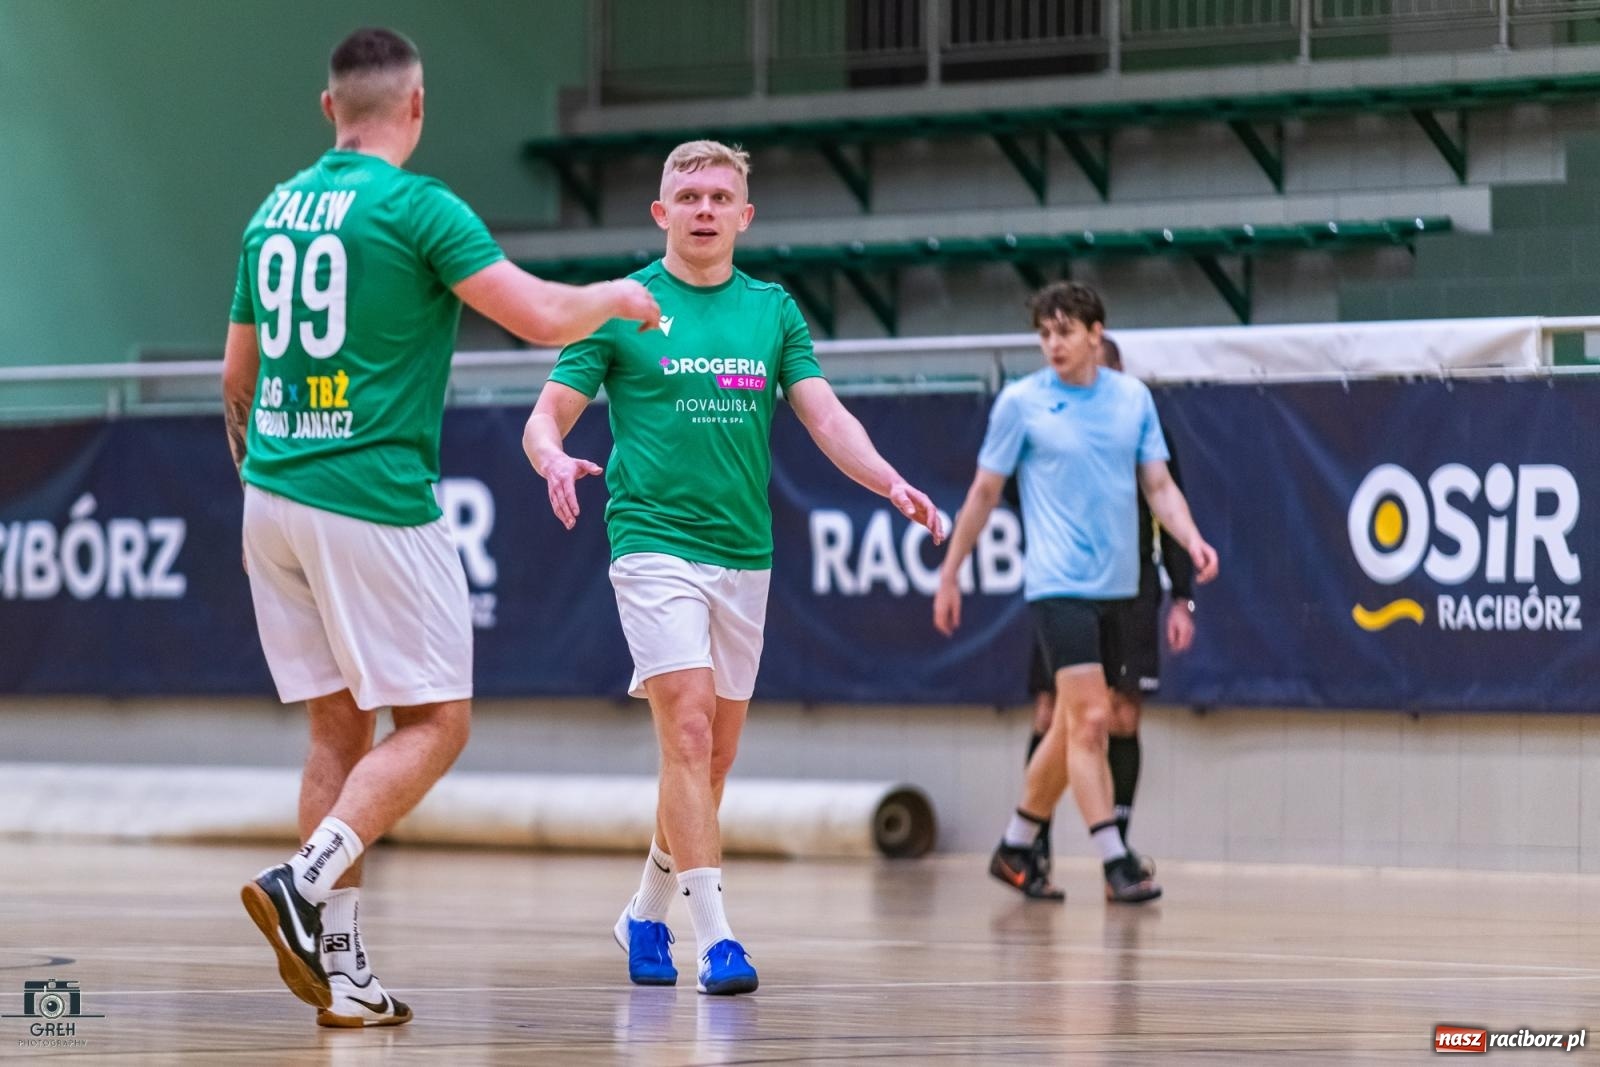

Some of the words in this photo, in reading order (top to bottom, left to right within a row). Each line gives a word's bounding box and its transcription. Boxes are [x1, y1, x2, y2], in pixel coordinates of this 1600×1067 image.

[264, 190, 356, 232] ZALEW
[258, 233, 348, 359] 99
[662, 357, 767, 376] DROGERIA
[306, 369, 349, 408] TBŻ
[721, 377, 732, 387] W
[291, 410, 354, 439] JANACZ
[692, 416, 721, 424] RESORT
[1437, 585, 1583, 631] RACIBÓRZ
[321, 933, 350, 953] FS
